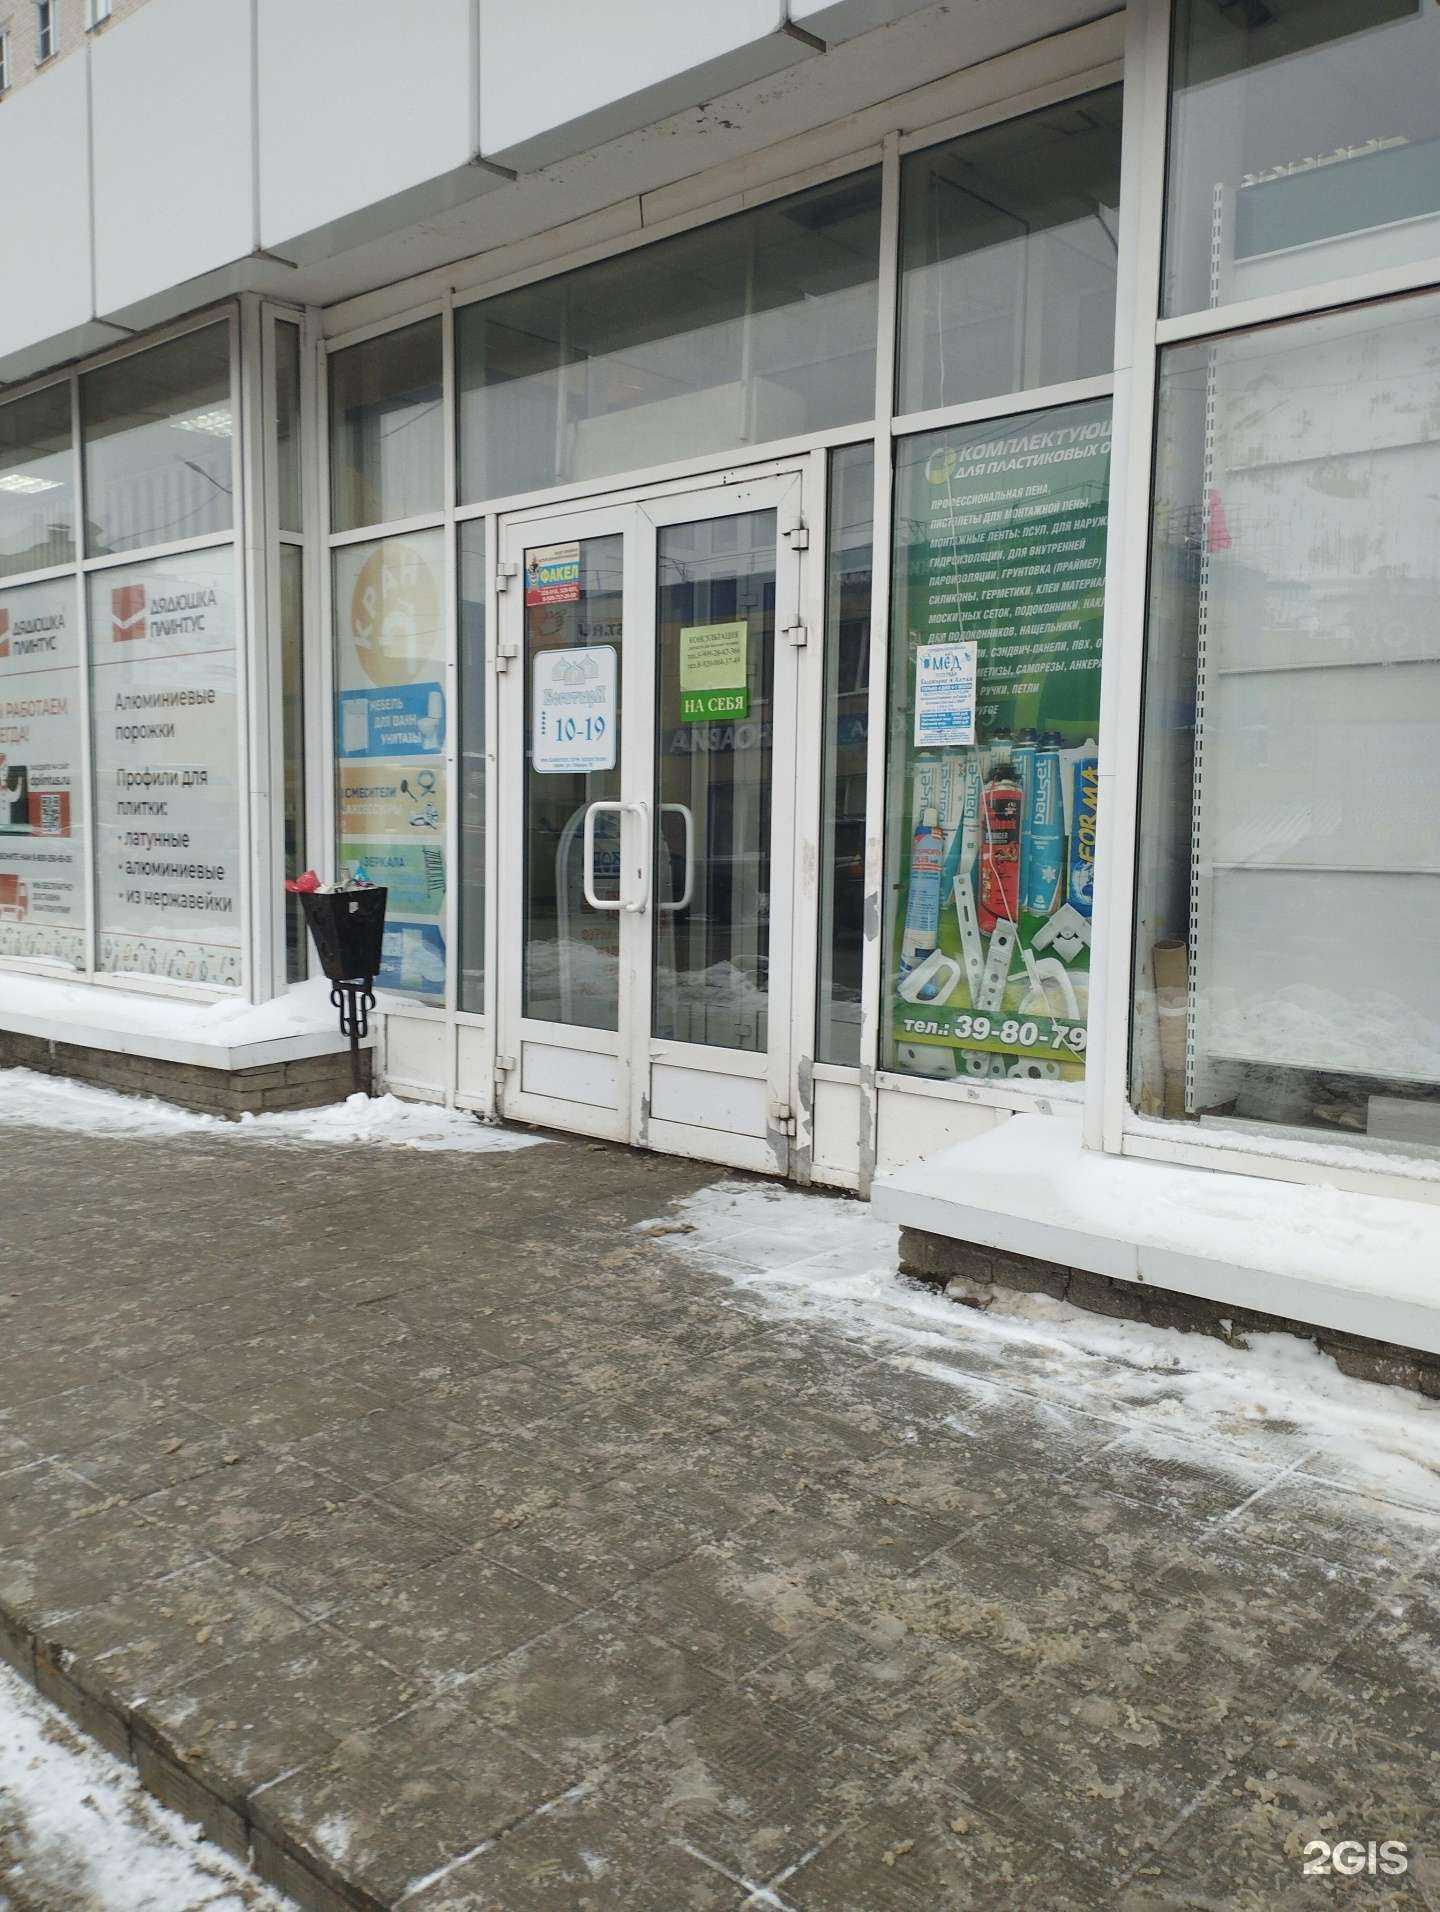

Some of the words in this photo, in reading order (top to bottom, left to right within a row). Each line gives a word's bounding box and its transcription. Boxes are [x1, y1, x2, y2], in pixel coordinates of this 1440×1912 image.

[954, 463, 985, 480] ДЛЯ
[986, 443, 1099, 474] ПЛАСТИКОВЫХ
[931, 488, 1024, 510] ПРОФЕССИОНАЛЬНАЯ
[930, 514, 982, 529] ПИСТОЛЕТЫ
[983, 510, 1002, 525] ДЛЯ
[1004, 501, 1061, 520] МОНТАЖНОЙ
[929, 533, 987, 548] МОНТАЖНЫЕ
[987, 529, 1020, 542] ЛЕНТЫ:
[1051, 521, 1072, 535] ДЛЯ
[1007, 547, 1028, 560] ДЛЯ
[1029, 538, 1087, 556] ВНУТРЕННЕЙ
[540, 564, 579, 583] ФАКЕЛ
[1001, 564, 1051, 579] ГРУНТОВКА
[1053, 558, 1102, 574] (ПРАЙМЕР)
[150, 589, 217, 615] ДЯДЮШКА
[12, 613, 66, 636] ДЯДЮШКА
[150, 614, 205, 638] ПЛИНТУС
[928, 610, 982, 624] МОСКИТНЫХ
[12, 635, 56, 655] ПЛИНТУС
[115, 687, 216, 711] Алюминиевые
[1011, 683, 1040, 694] ПЕТЛИ
[6, 698, 67, 718] РАБОТАЕМ
[685, 698, 705, 713] НА
[707, 696, 744, 712] СЕБЯ
[115, 723, 175, 743] порожки
[380, 732, 423, 745] УНИТАЗЫ
[555, 715, 606, 741] 10-19
[116, 768, 179, 790] Профили
[180, 769, 208, 788] для
[344, 787, 397, 799] СМЕСИТЕЛИ
[919, 767, 933, 822] auset
[1033, 759, 1050, 825] bauset
[1078, 766, 1098, 863] FORMA
[124, 831, 190, 851] латунные
[125, 861, 225, 881] алюминиевые
[126, 890, 141, 904] из
[144, 891, 233, 913] нержавейки
[904, 1019, 949, 1036] тел.:
[954, 1014, 1087, 1052] 39-80-79
